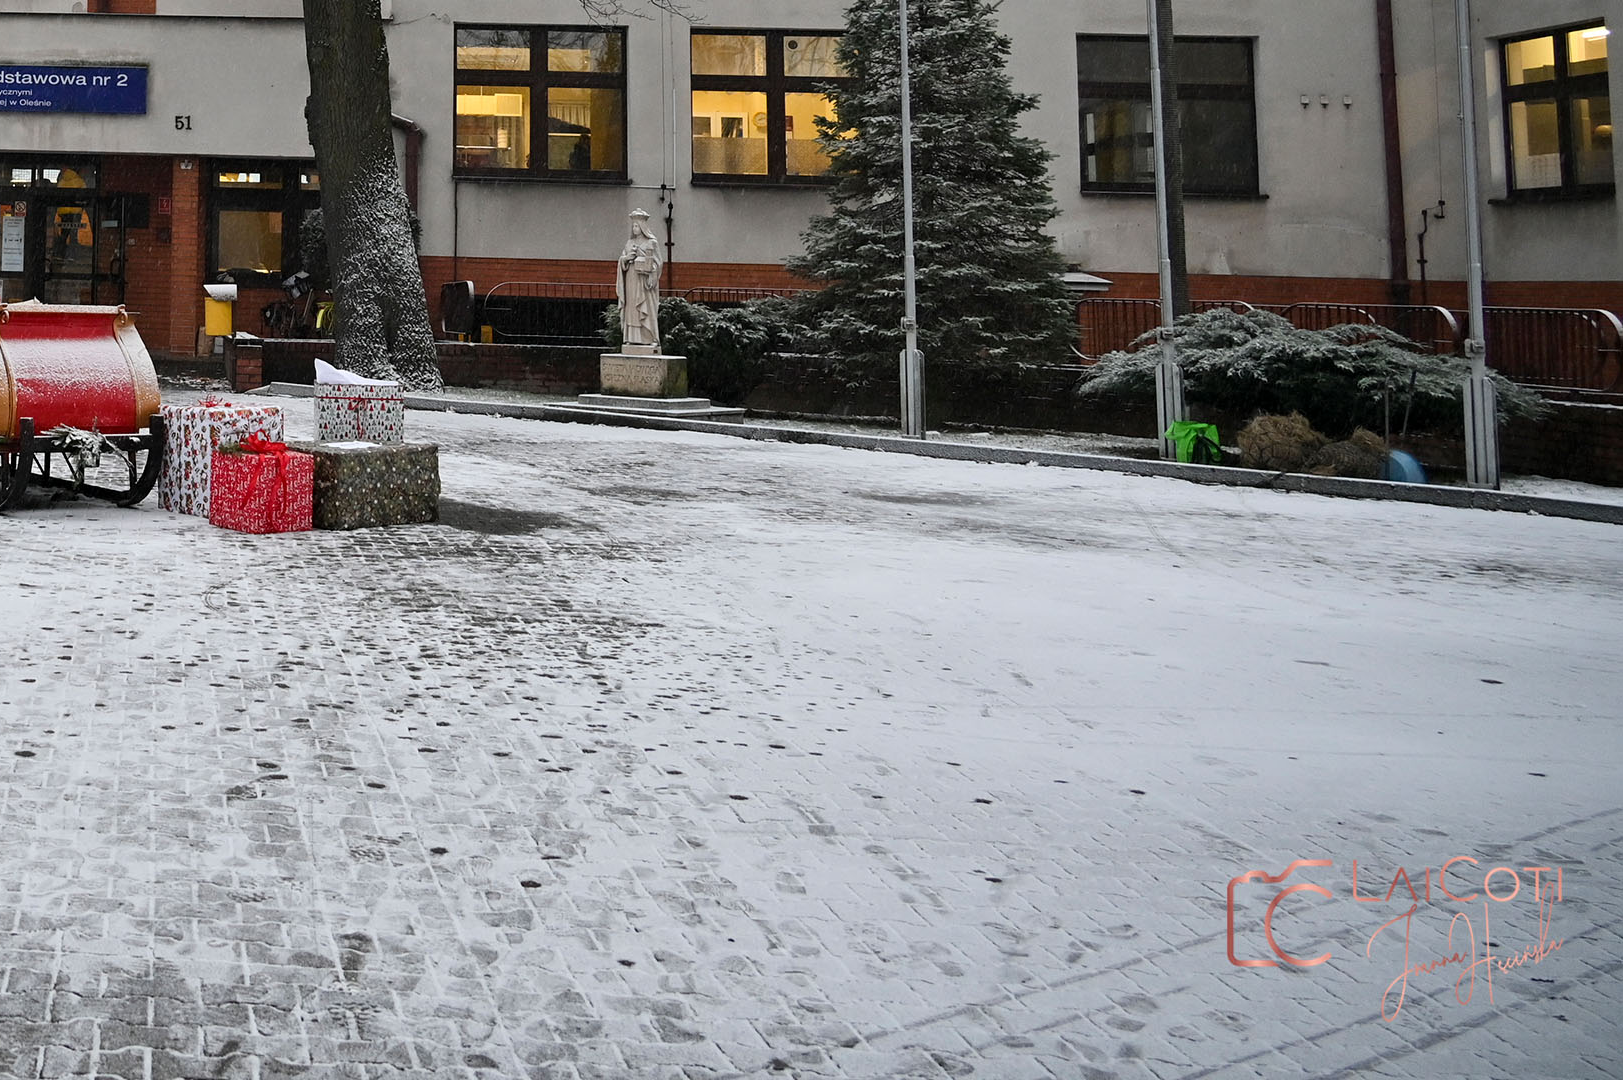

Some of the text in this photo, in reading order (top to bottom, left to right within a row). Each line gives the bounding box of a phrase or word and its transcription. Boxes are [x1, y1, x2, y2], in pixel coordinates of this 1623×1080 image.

[92, 75, 111, 86] nr
[116, 73, 128, 87] 2
[19, 98, 52, 107] Oleśnie
[174, 115, 193, 131] 51
